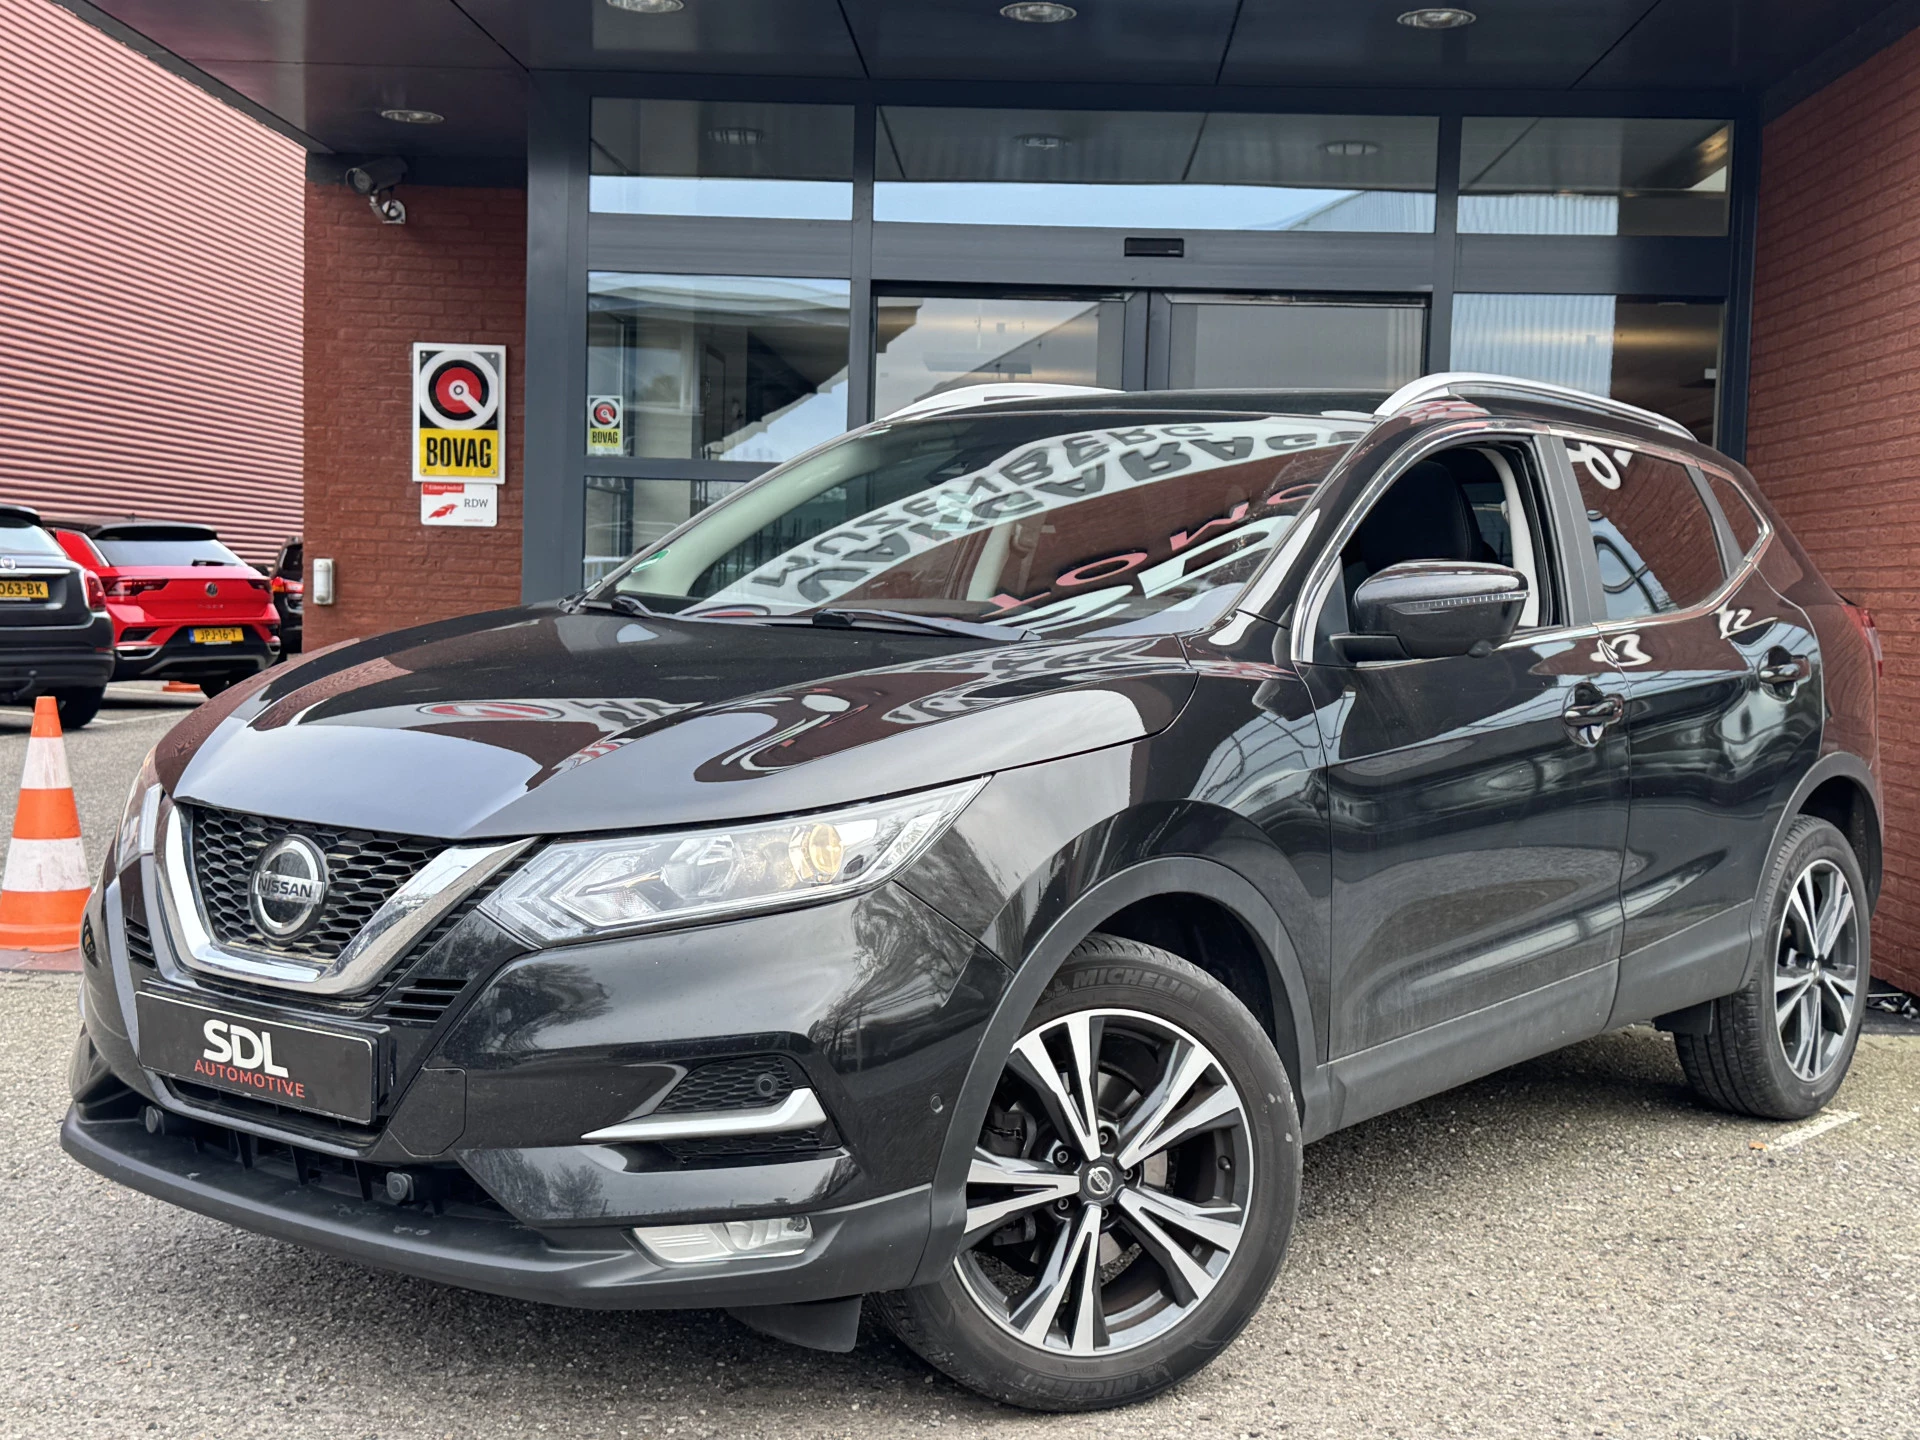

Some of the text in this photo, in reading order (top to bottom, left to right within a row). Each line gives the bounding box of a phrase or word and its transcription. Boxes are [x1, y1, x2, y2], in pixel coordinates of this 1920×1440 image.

[426, 436, 492, 468] BOVAG
[592, 430, 618, 444] BOVAG
[463, 498, 489, 508] RDW
[258, 876, 313, 899] NISSAN
[1071, 967, 1200, 1004] MICHELIN
[202, 1018, 290, 1079] SDL
[193, 1058, 306, 1100] AUTOMOTIVE
